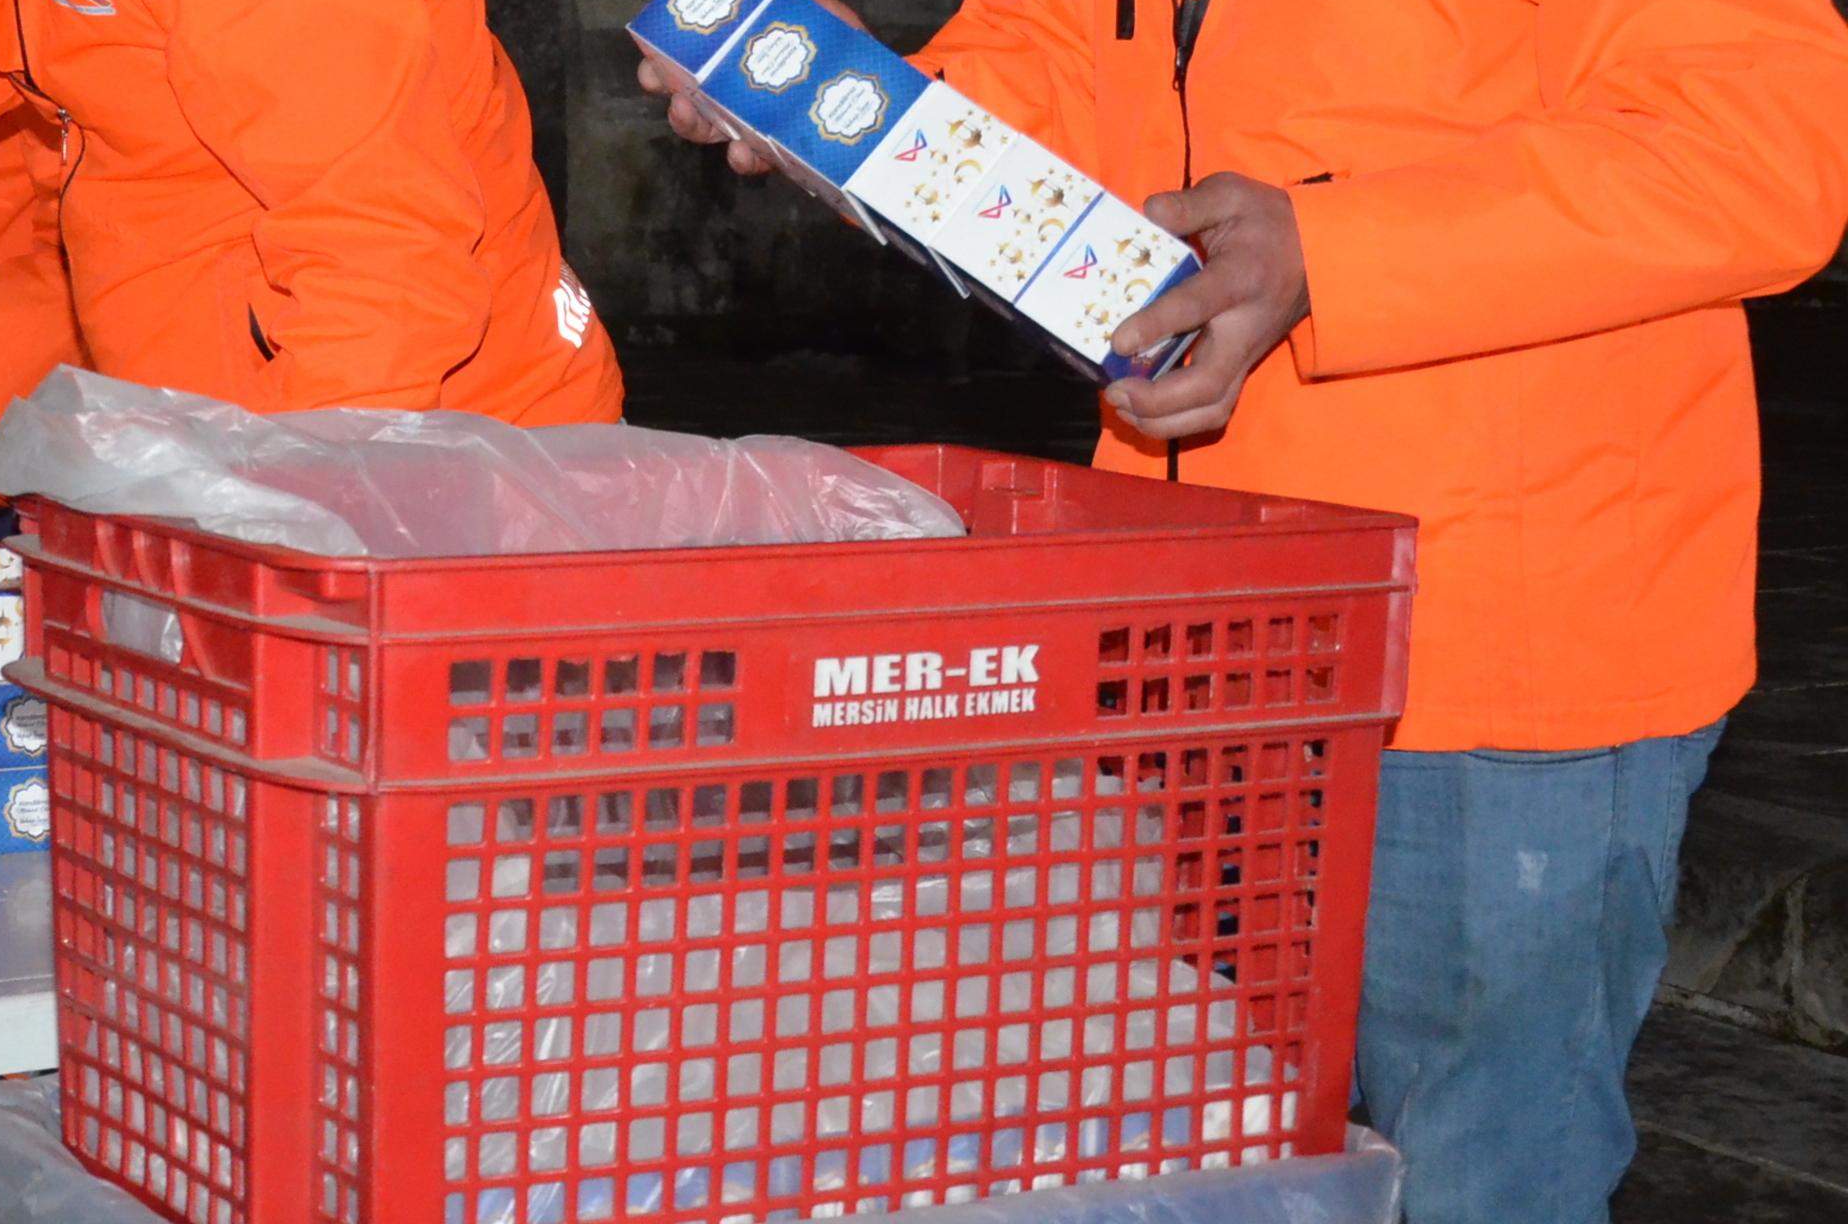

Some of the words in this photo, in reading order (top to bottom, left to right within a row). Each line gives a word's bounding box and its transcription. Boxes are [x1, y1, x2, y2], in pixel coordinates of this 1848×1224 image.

[813, 644, 1040, 698] MER-EK
[904, 694, 959, 721] HALK
[964, 687, 1036, 717] EKMEK
